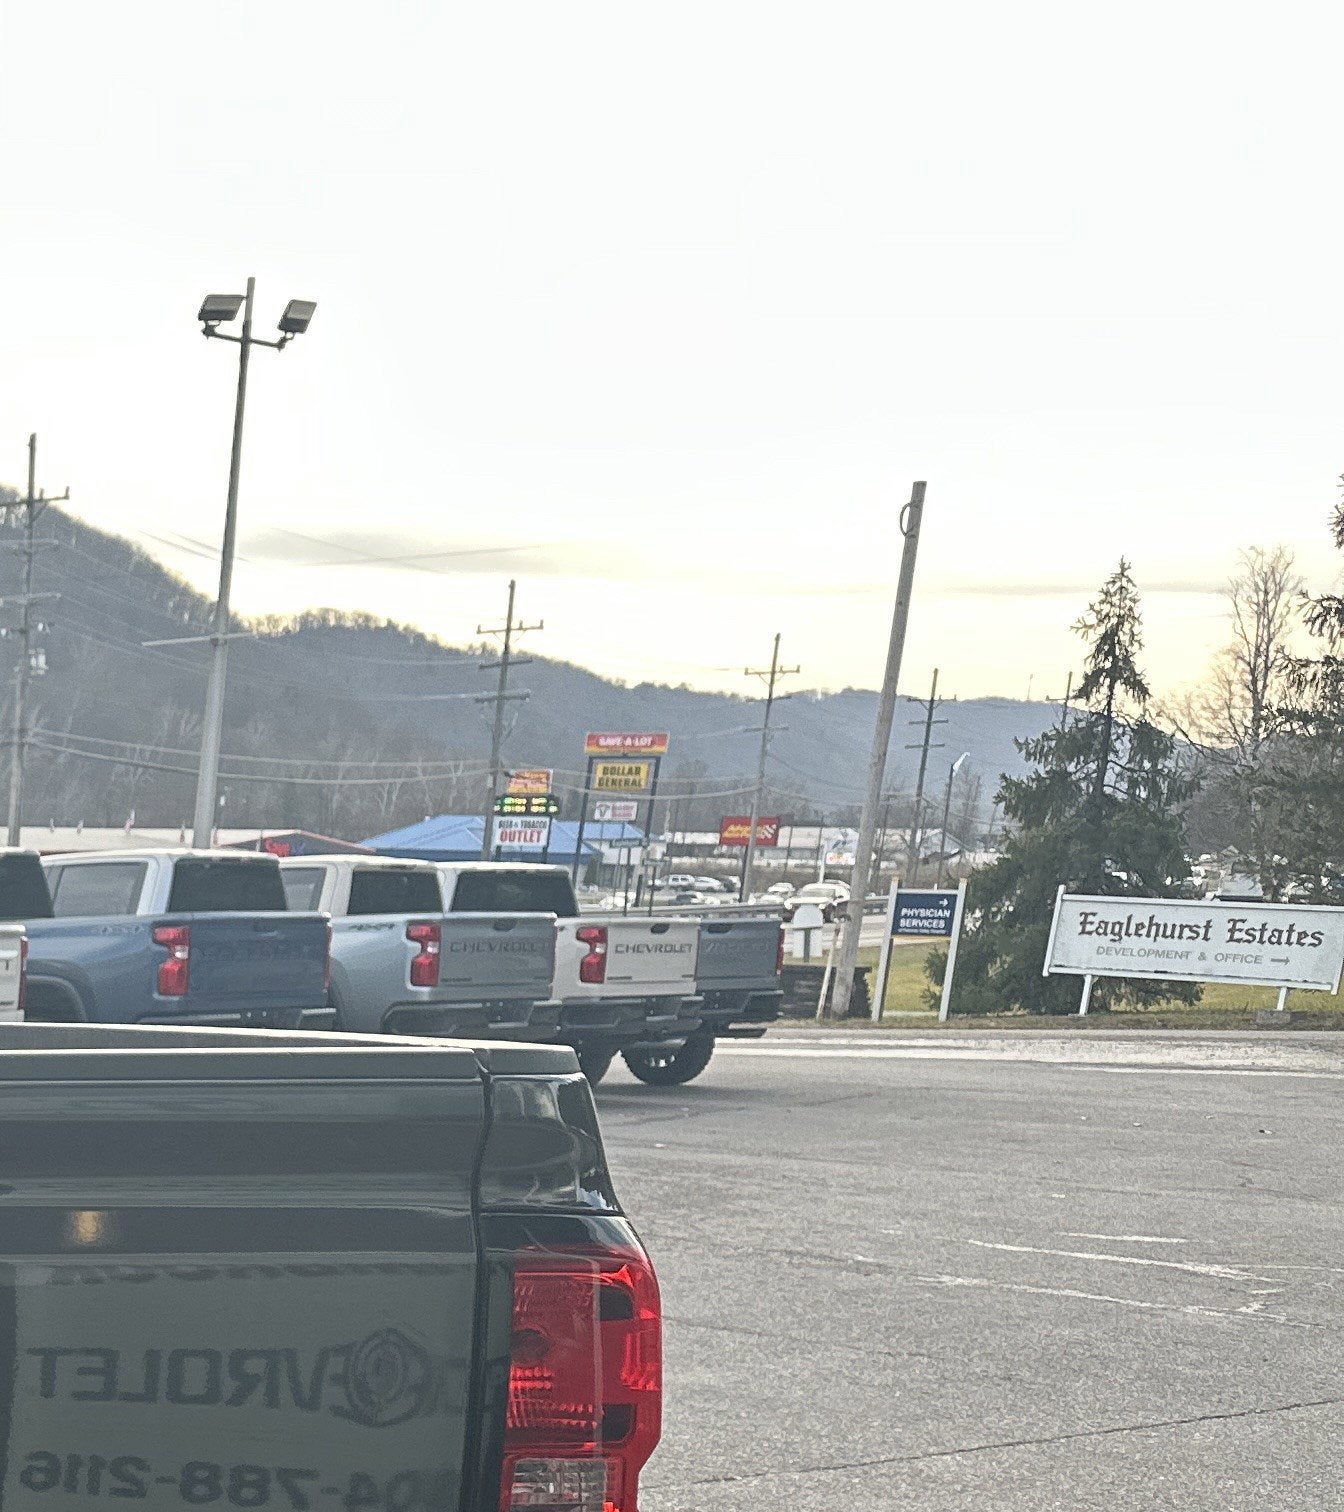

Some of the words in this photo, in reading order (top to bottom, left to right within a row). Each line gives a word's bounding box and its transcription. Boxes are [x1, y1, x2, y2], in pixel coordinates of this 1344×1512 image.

[602, 766, 641, 776] DOLLAR
[597, 777, 642, 788] GENERAL
[500, 830, 542, 843] OUTLET
[900, 907, 951, 918] PHYSICIAN
[899, 918, 946, 929] SERVICES
[1078, 911, 1213, 943] Eaglehurst
[1226, 918, 1325, 948] Estates
[615, 943, 693, 954] CHEVROLET
[1096, 945, 1192, 961] DEVELOPMENT
[1198, 952, 1207, 962] &
[1215, 952, 1264, 965] OFFICE
